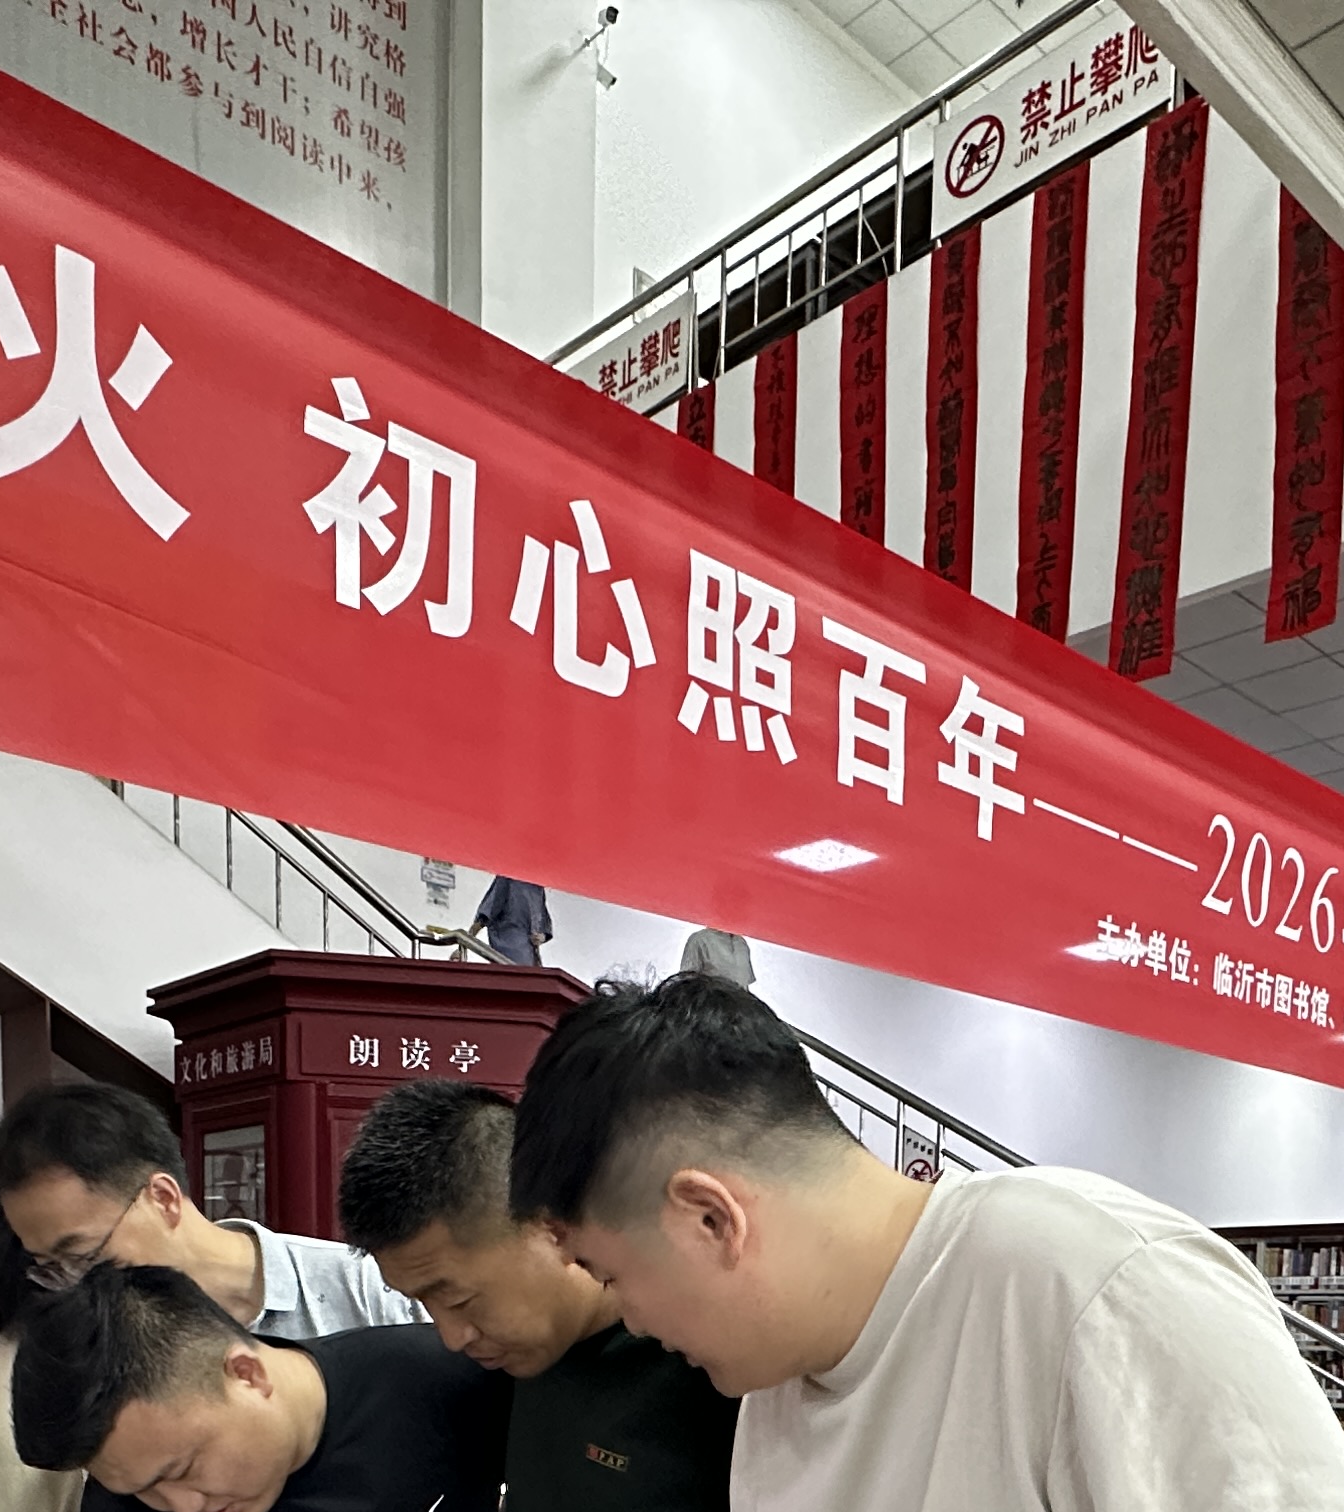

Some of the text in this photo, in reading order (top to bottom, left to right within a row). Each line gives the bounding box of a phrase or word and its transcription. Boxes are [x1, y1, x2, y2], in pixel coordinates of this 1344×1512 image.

[1019, 24, 1159, 145] 禁止攀爬
[1013, 69, 1160, 169] JIN ZHI PAN PA
[598, 317, 682, 397] 禁止攀爬
[637, 375, 661, 398] PAN
[664, 362, 681, 381] PA
[180, 1035, 273, 1085] 文化和旅游局
[349, 1034, 481, 1074] 朗读亭
